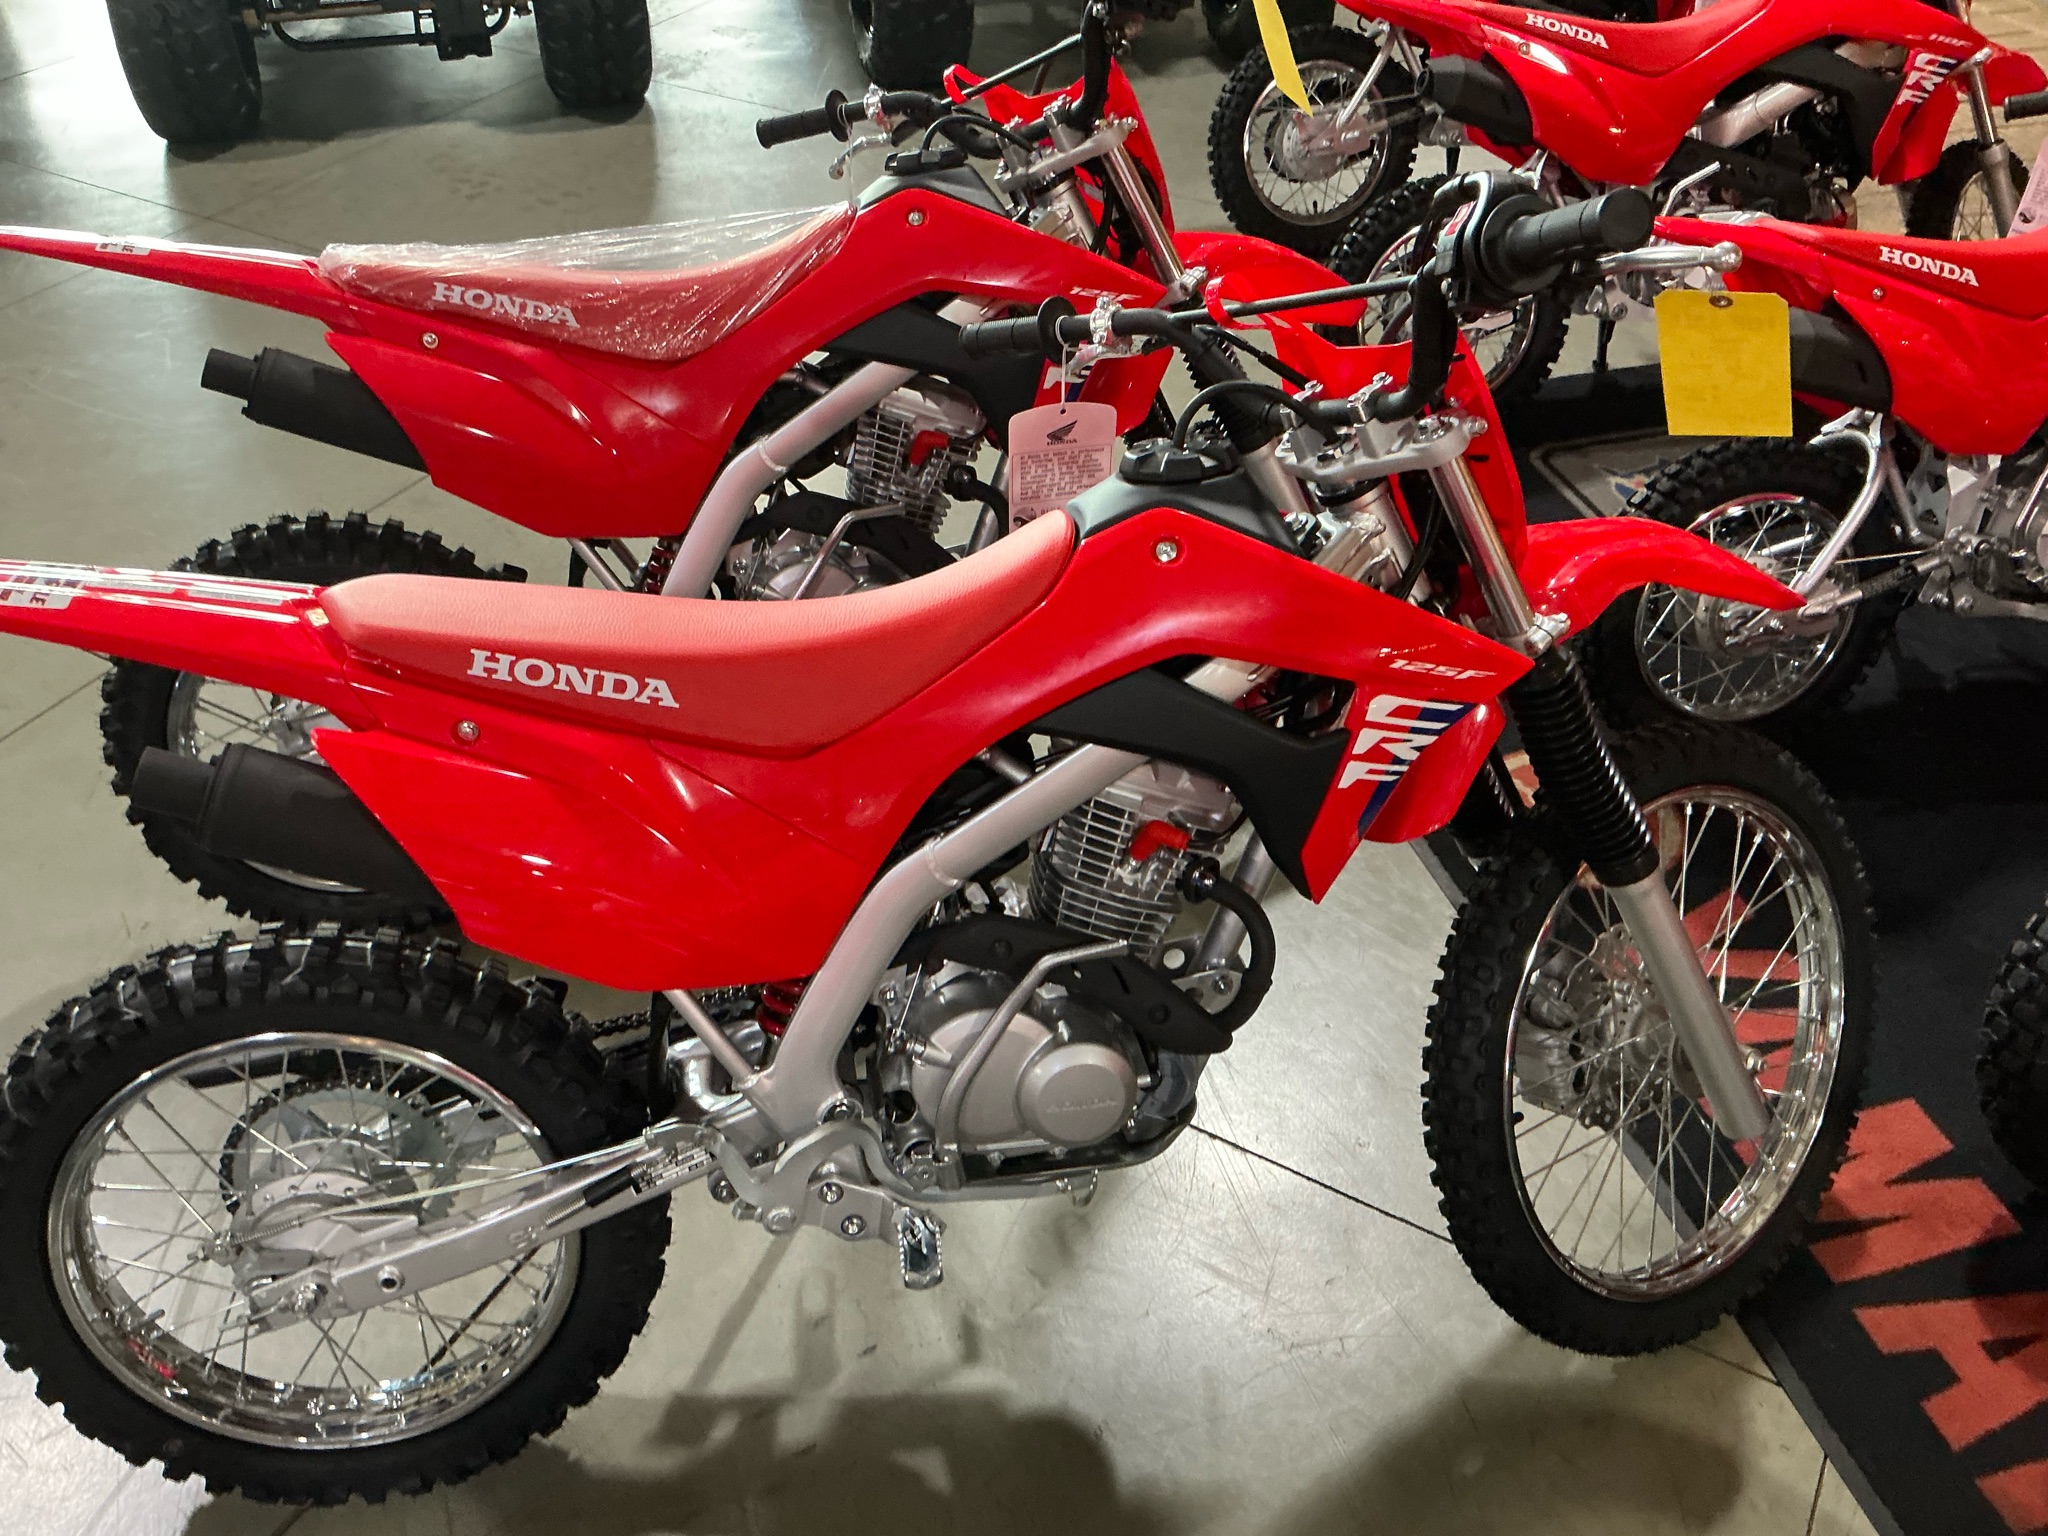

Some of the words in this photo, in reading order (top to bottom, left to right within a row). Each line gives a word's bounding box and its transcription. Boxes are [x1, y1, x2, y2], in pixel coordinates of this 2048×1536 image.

[1525, 12, 1609, 50] HONDA
[1879, 245, 1980, 287] HONDA
[431, 281, 581, 329] HONDA
[466, 648, 680, 709] HONDA
[1388, 658, 1497, 680] 125F
[1338, 694, 1464, 789] CRF
